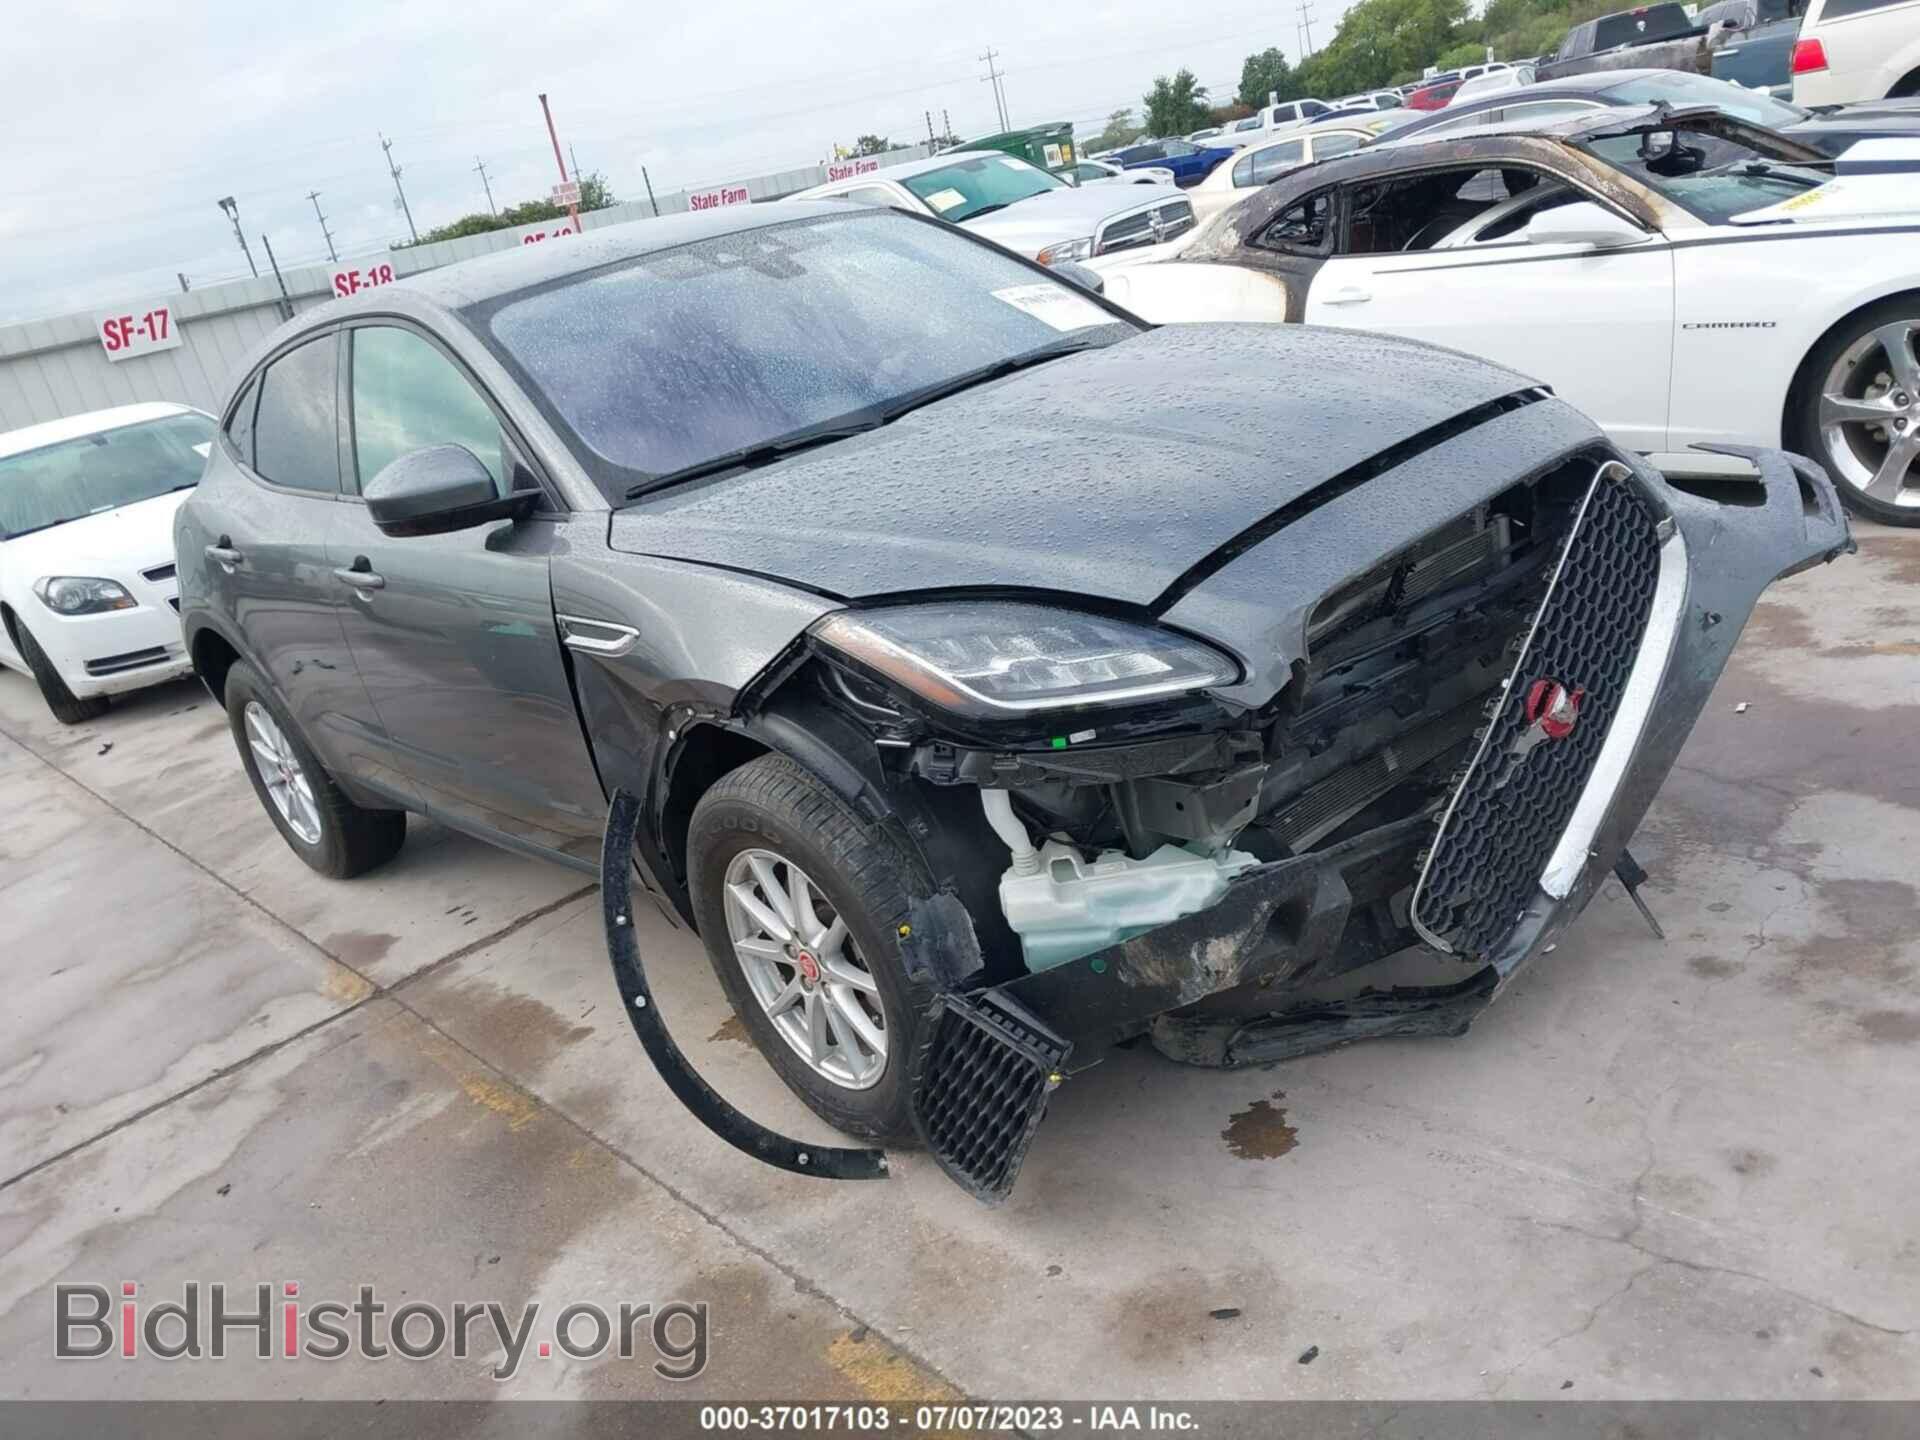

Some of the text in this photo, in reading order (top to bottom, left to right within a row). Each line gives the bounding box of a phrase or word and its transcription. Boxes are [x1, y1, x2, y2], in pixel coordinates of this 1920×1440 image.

[829, 158, 880, 182] State Farm
[690, 187, 748, 212] State Farm
[335, 264, 394, 299] SF-18
[102, 308, 169, 352] SF-17
[1682, 321, 1777, 330] CAMARO
